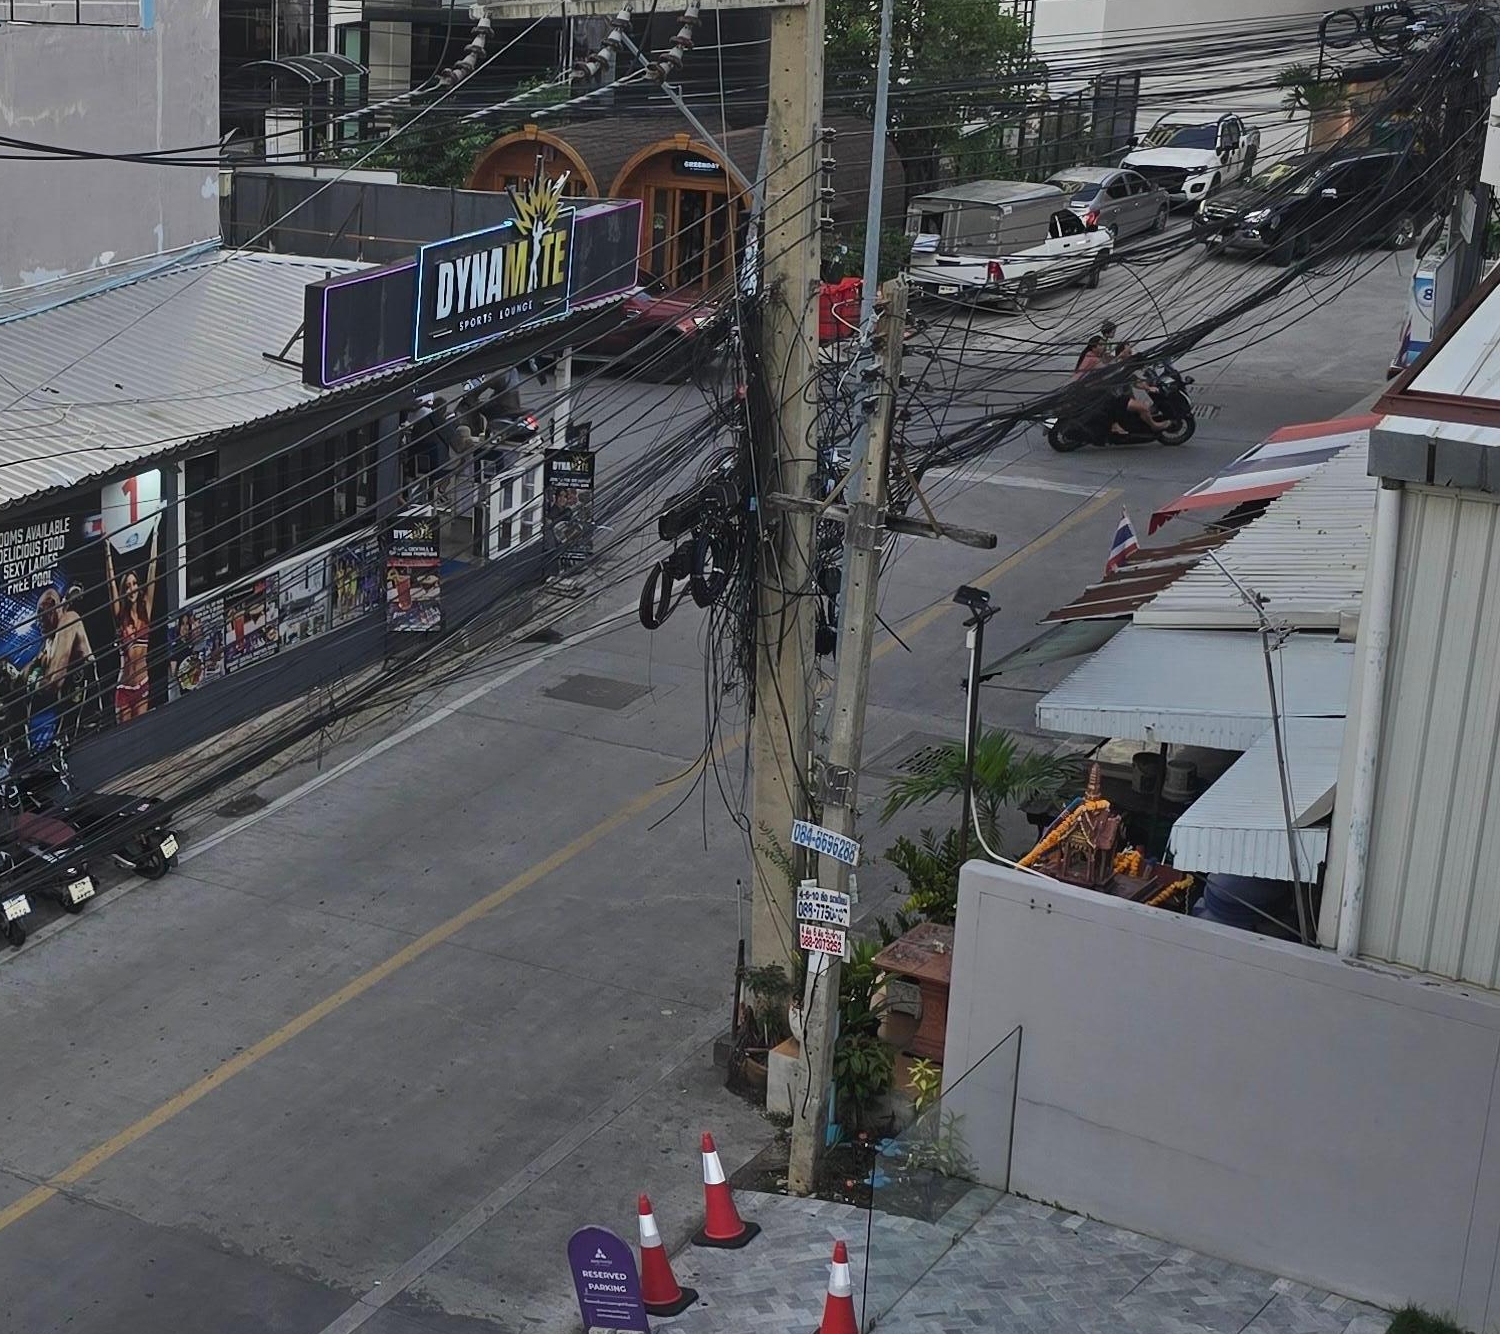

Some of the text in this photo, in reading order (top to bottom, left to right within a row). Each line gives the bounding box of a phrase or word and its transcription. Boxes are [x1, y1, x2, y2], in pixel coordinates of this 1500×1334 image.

[435, 229, 568, 321] DYNAMITE
[459, 299, 534, 332] SPORTS LOUNGE
[121, 475, 139, 524] 1
[25, 517, 71, 543] AVAILABLE
[43, 535, 65, 551] FOOD
[3, 553, 59, 580] SEXY LADIES
[7, 572, 54, 595] FREE POOL
[582, 1270, 627, 1281] RESERVED
[588, 1282, 627, 1293] PARKING
